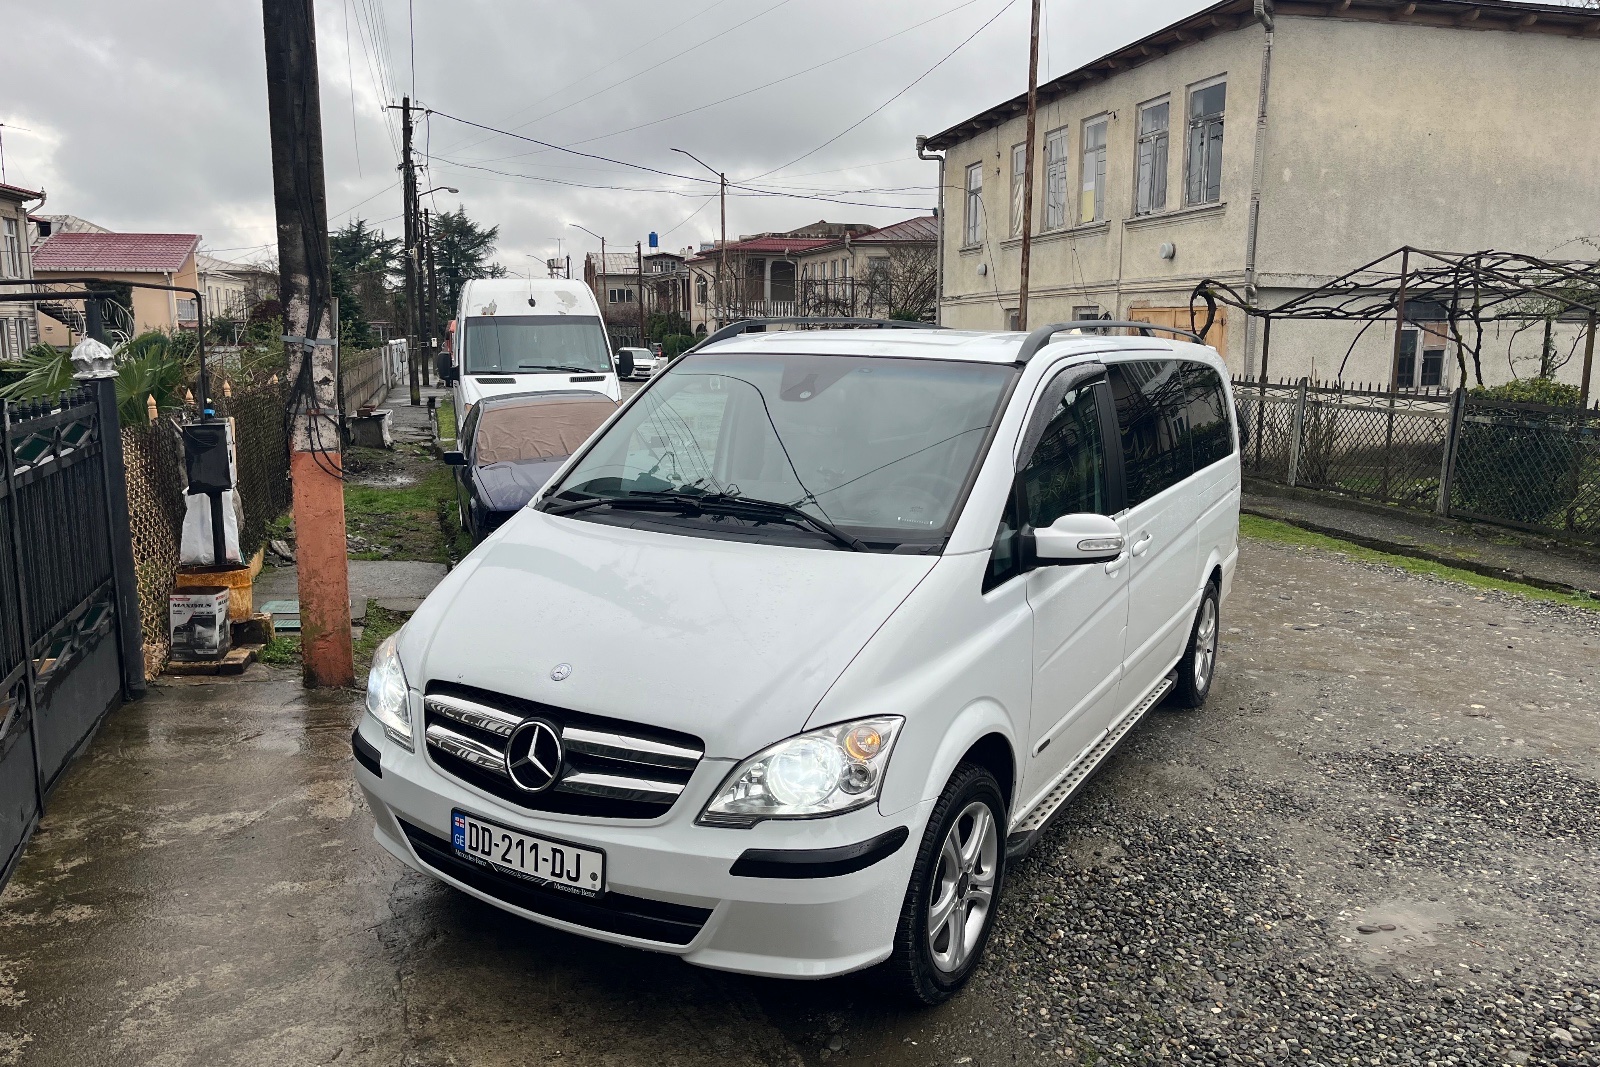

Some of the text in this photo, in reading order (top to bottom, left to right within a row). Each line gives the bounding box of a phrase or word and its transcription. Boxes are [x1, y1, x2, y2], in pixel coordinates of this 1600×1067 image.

[454, 833, 465, 847] GE
[468, 821, 581, 882] DD-211-DJ
[553, 882, 596, 898] Mercedes-Benz
